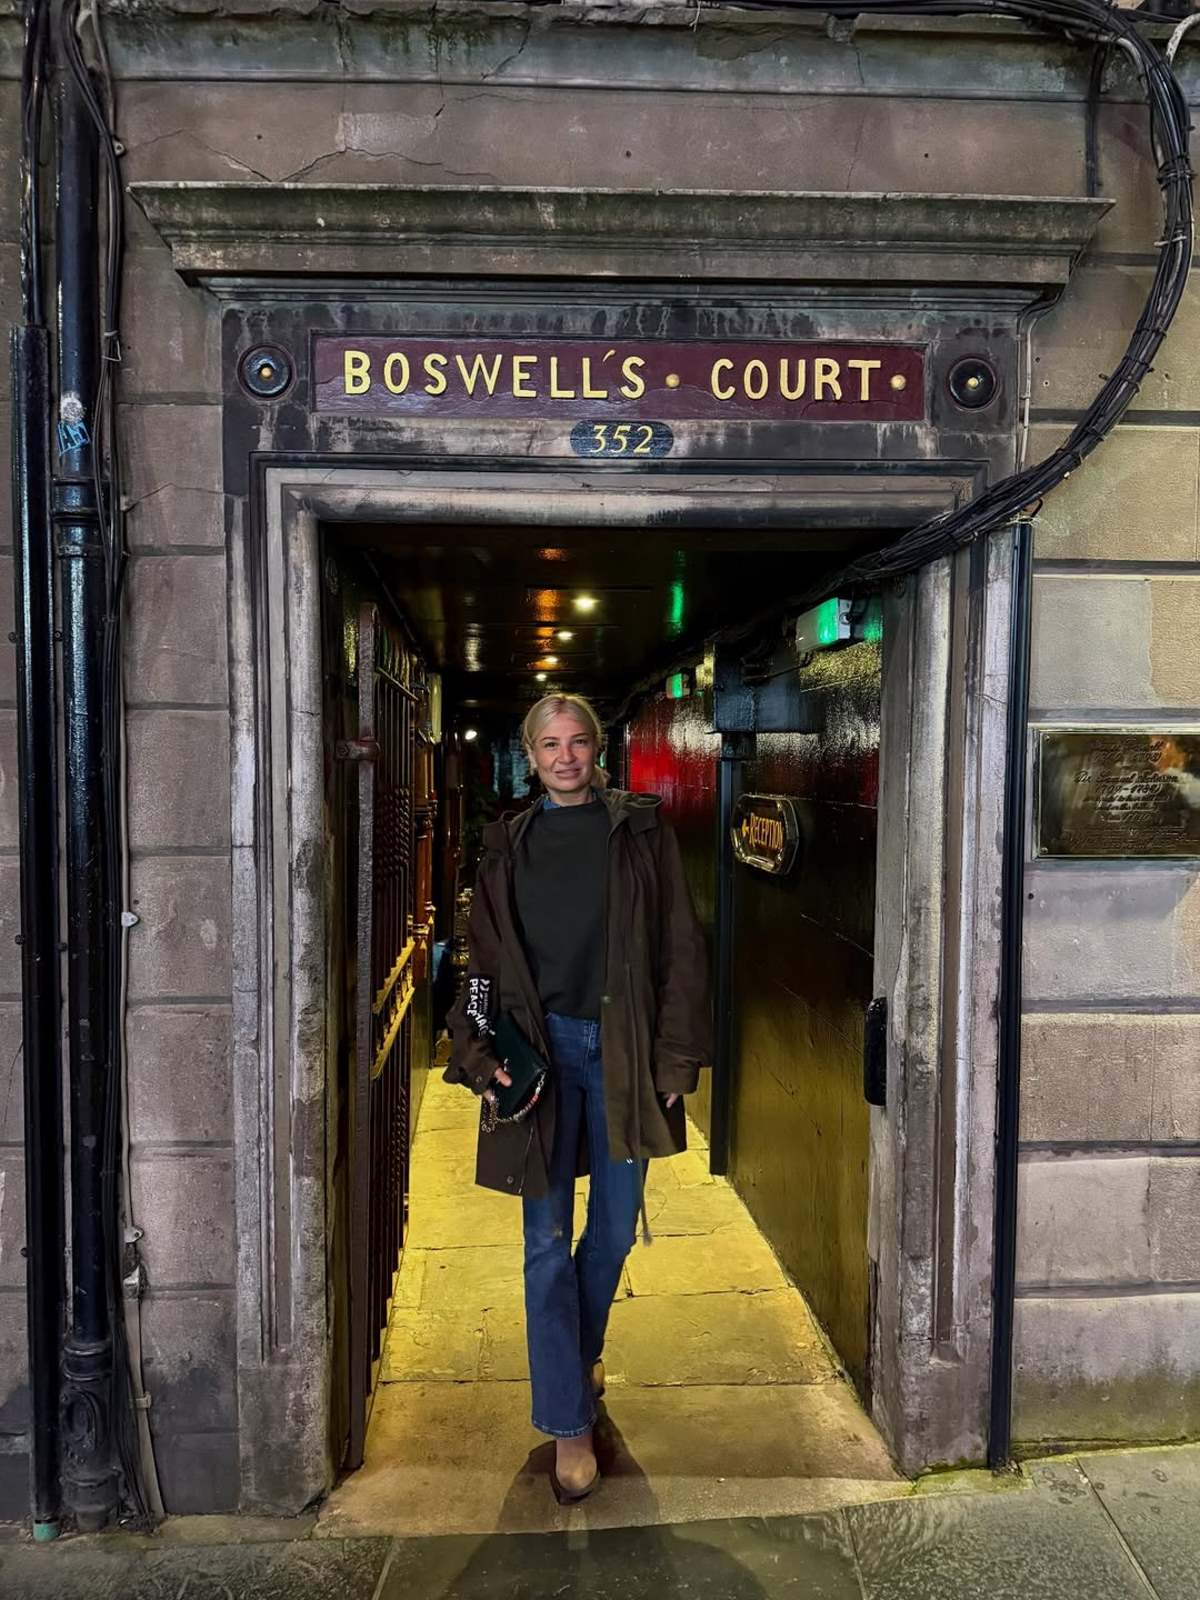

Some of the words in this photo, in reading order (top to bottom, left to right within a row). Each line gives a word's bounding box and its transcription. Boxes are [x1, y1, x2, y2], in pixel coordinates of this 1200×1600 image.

[344, 349, 646, 399] BOSWELL'S
[711, 358, 881, 401] COURT
[589, 424, 653, 454] 352
[749, 813, 783, 849] RECEPTION
